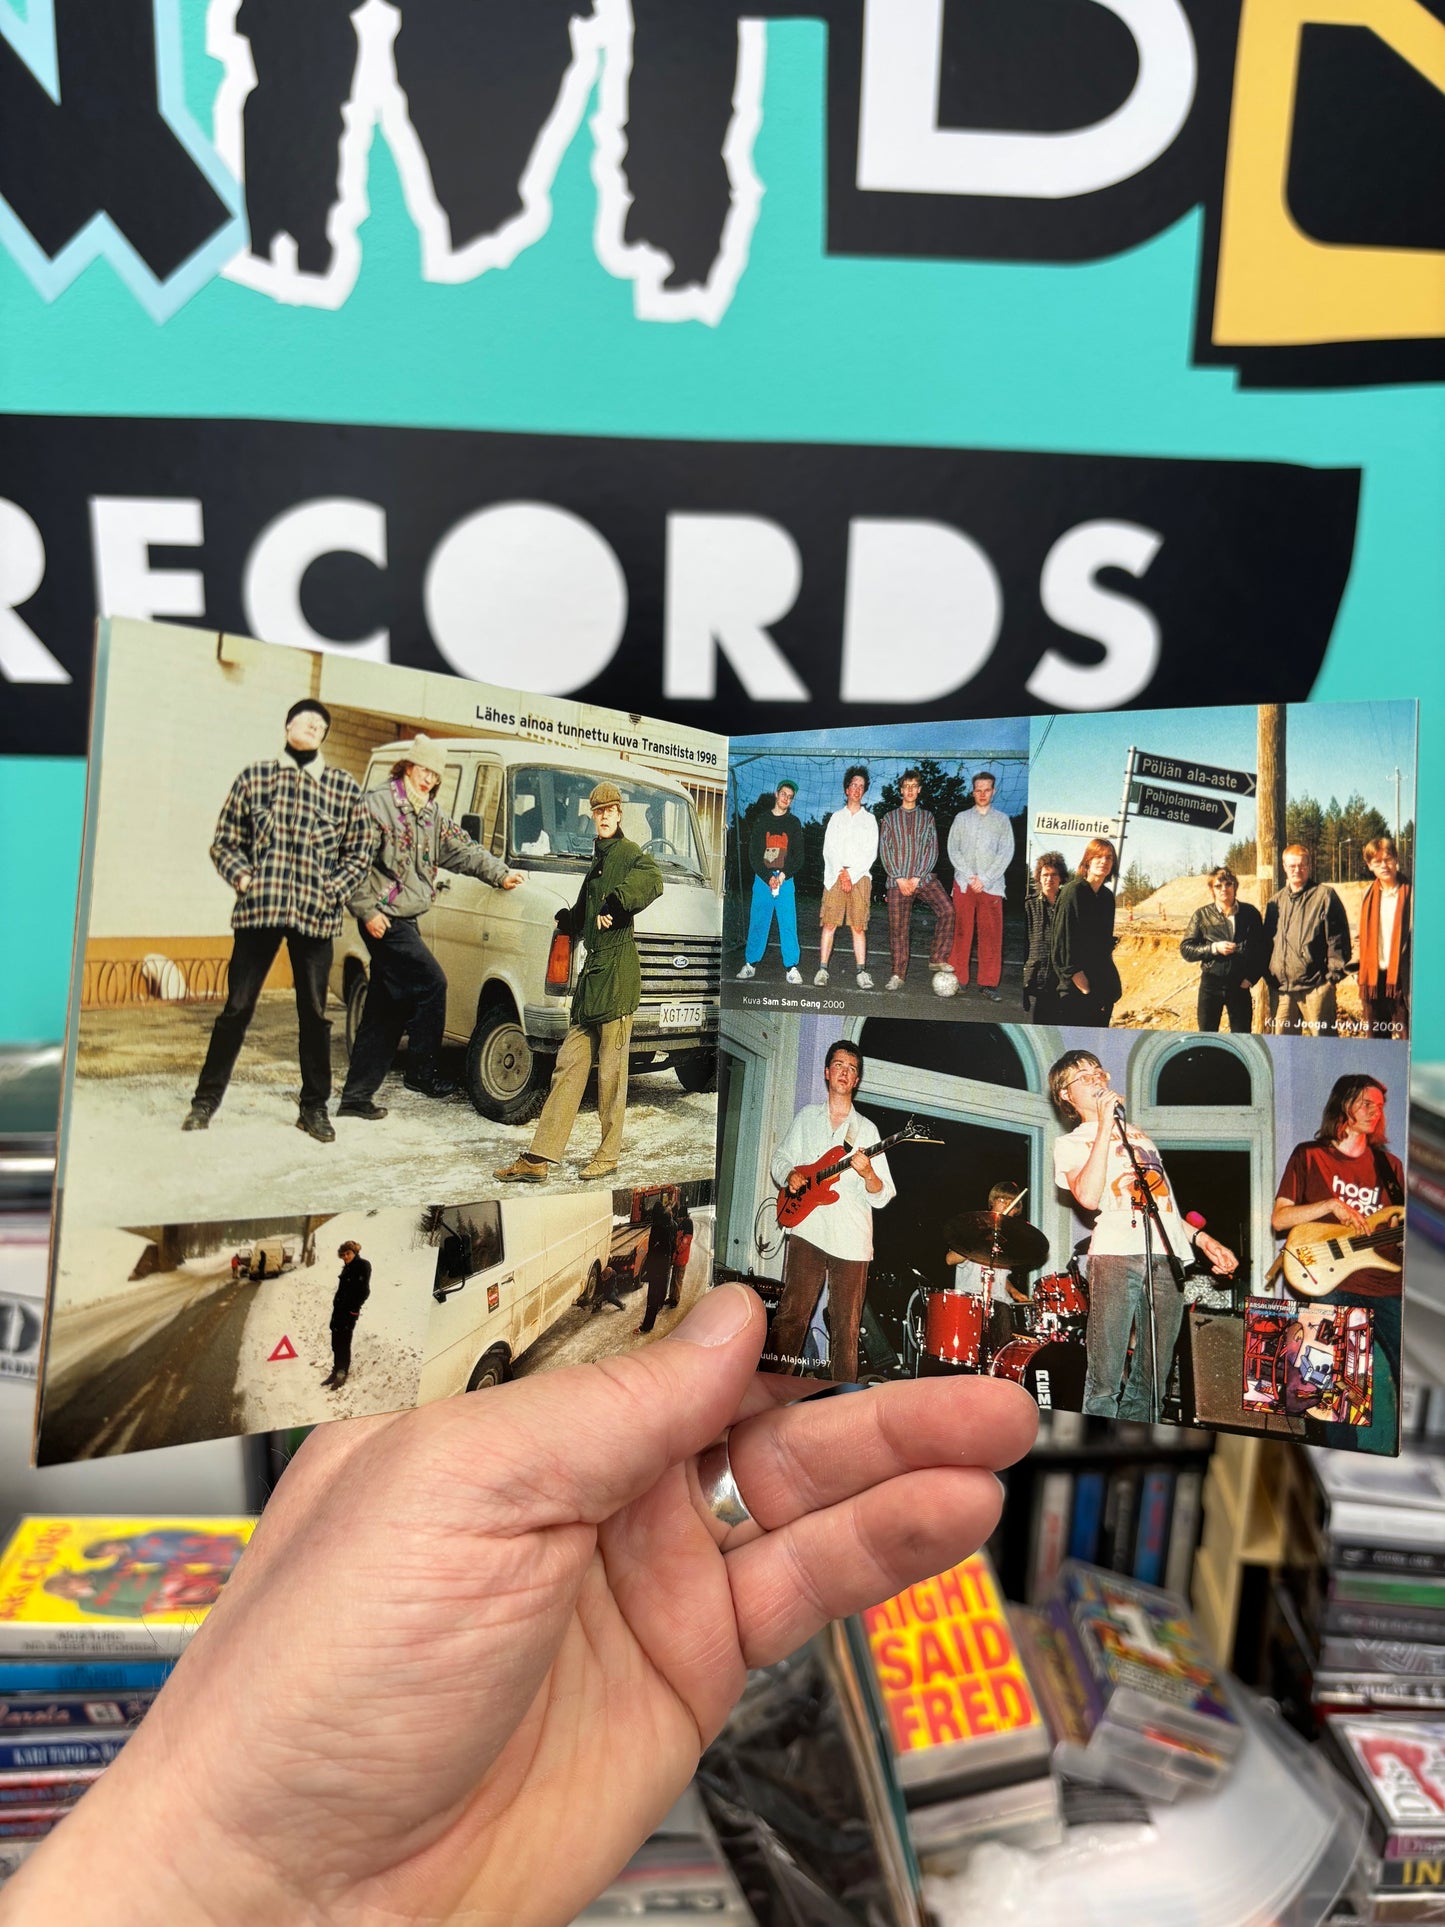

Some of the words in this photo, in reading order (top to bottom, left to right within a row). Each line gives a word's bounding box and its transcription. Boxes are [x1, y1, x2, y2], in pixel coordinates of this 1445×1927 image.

[476, 705, 516, 726] Lähes
[520, 714, 554, 733] ainoa
[557, 721, 609, 743] tunnettu
[613, 732, 639, 749] kuva
[642, 738, 694, 761] Transitista
[697, 750, 717, 765] 1998
[1142, 757, 1182, 779] Pöljän
[1187, 769, 1238, 789] ala-aste
[1145, 788, 1219, 814] Pohjolanmäen
[1036, 816, 1110, 834] Itäkalliontie
[663, 1007, 700, 1023] XGT-775
[742, 996, 761, 1005] Kuva
[762, 997, 779, 1006] Sam
[781, 998, 799, 1007] Sam
[800, 999, 821, 1009] Gang
[823, 1000, 845, 1009] 2000
[1264, 1018, 1291, 1028] Kuva
[1293, 1018, 1328, 1031] Jooga
[1372, 1021, 1404, 1032] 2000
[1332, 1174, 1380, 1206] hogi
[760, 1352, 779, 1361] uula
[780, 1354, 810, 1365] Alajoki
[812, 1358, 832, 1368] 1997
[879, 1618, 1011, 1691] SAID
[887, 1675, 1033, 1757] FRED
